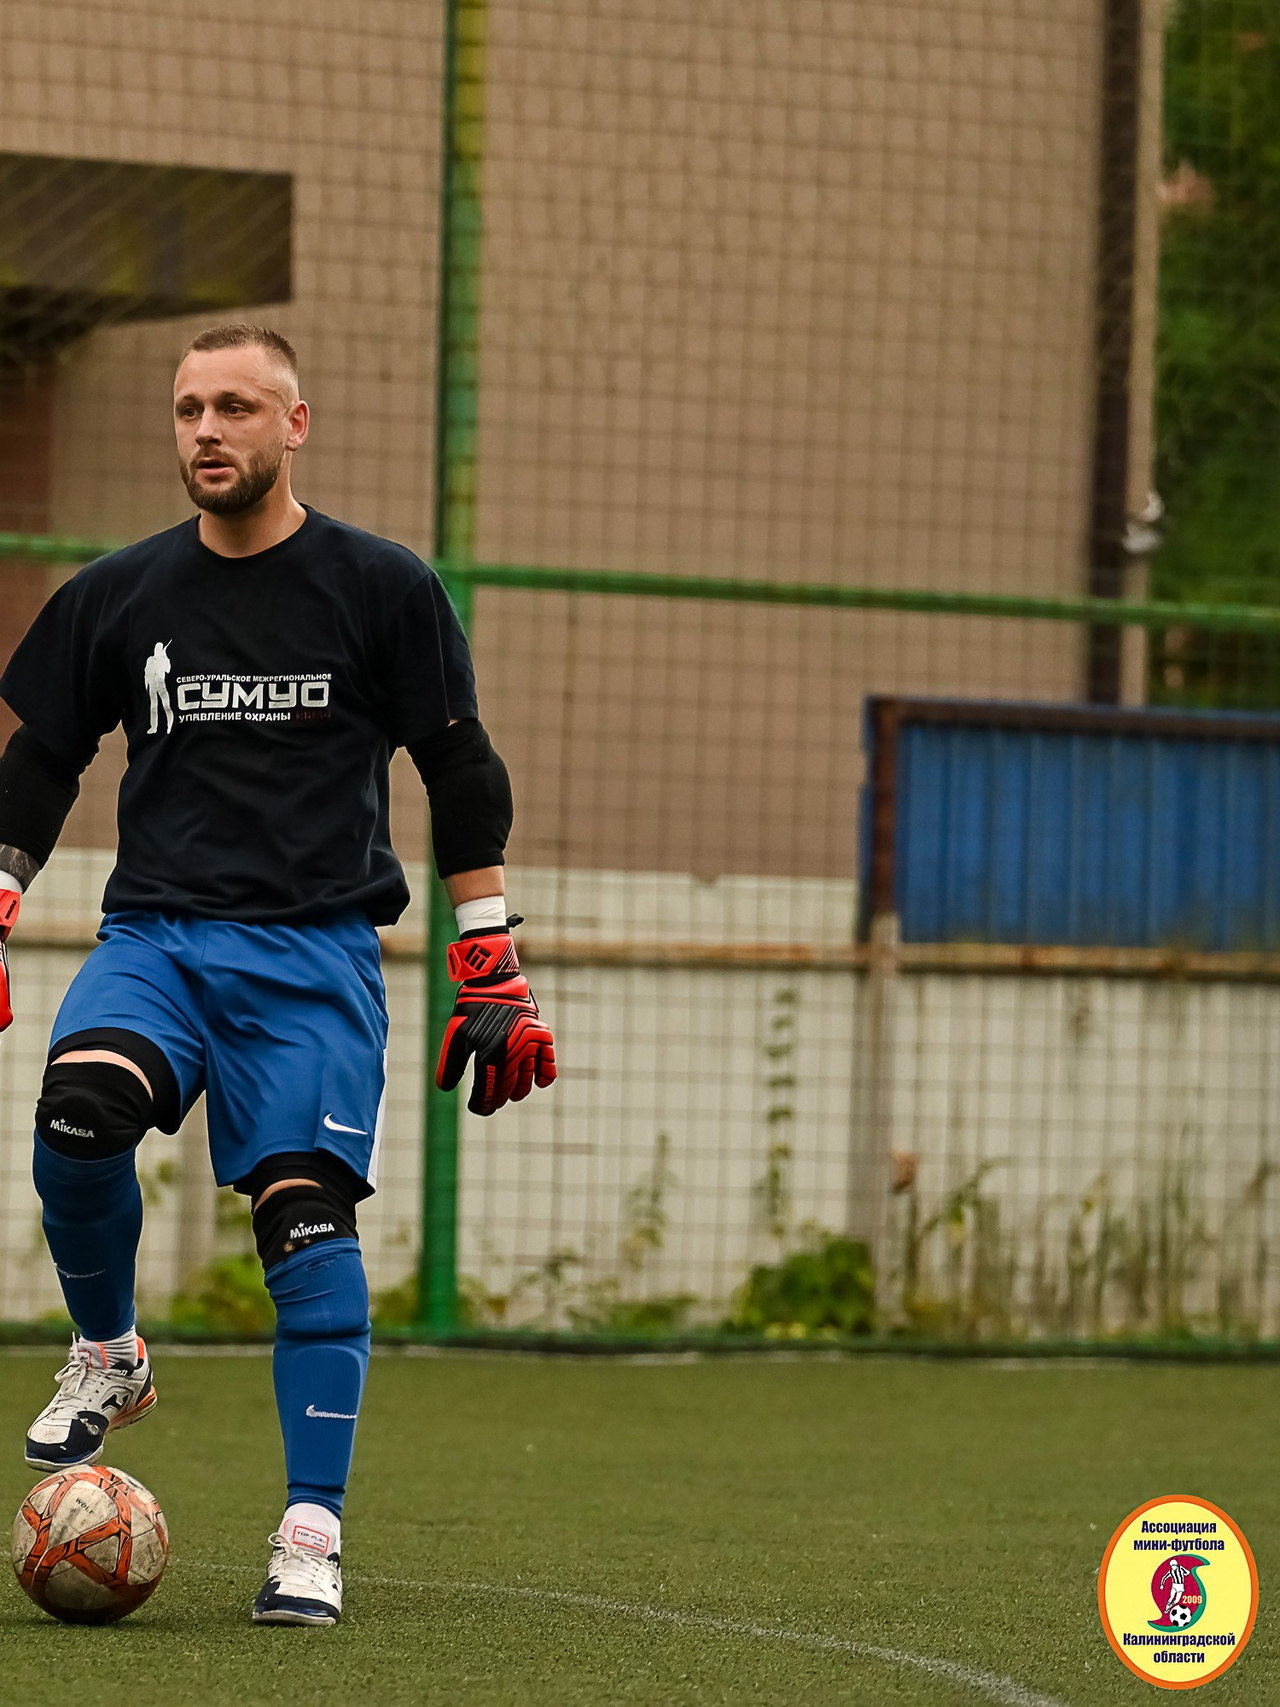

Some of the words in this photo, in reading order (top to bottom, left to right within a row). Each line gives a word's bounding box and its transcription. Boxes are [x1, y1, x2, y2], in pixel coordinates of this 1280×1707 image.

[176, 673, 251, 683] СЕВЕРО-УРАЛЬСКОЕ
[252, 673, 332, 683] МЕЖРЕГИОНАЛЬНОЕ
[176, 681, 330, 711] СУМУО
[244, 711, 291, 722] ОХРАНЫ
